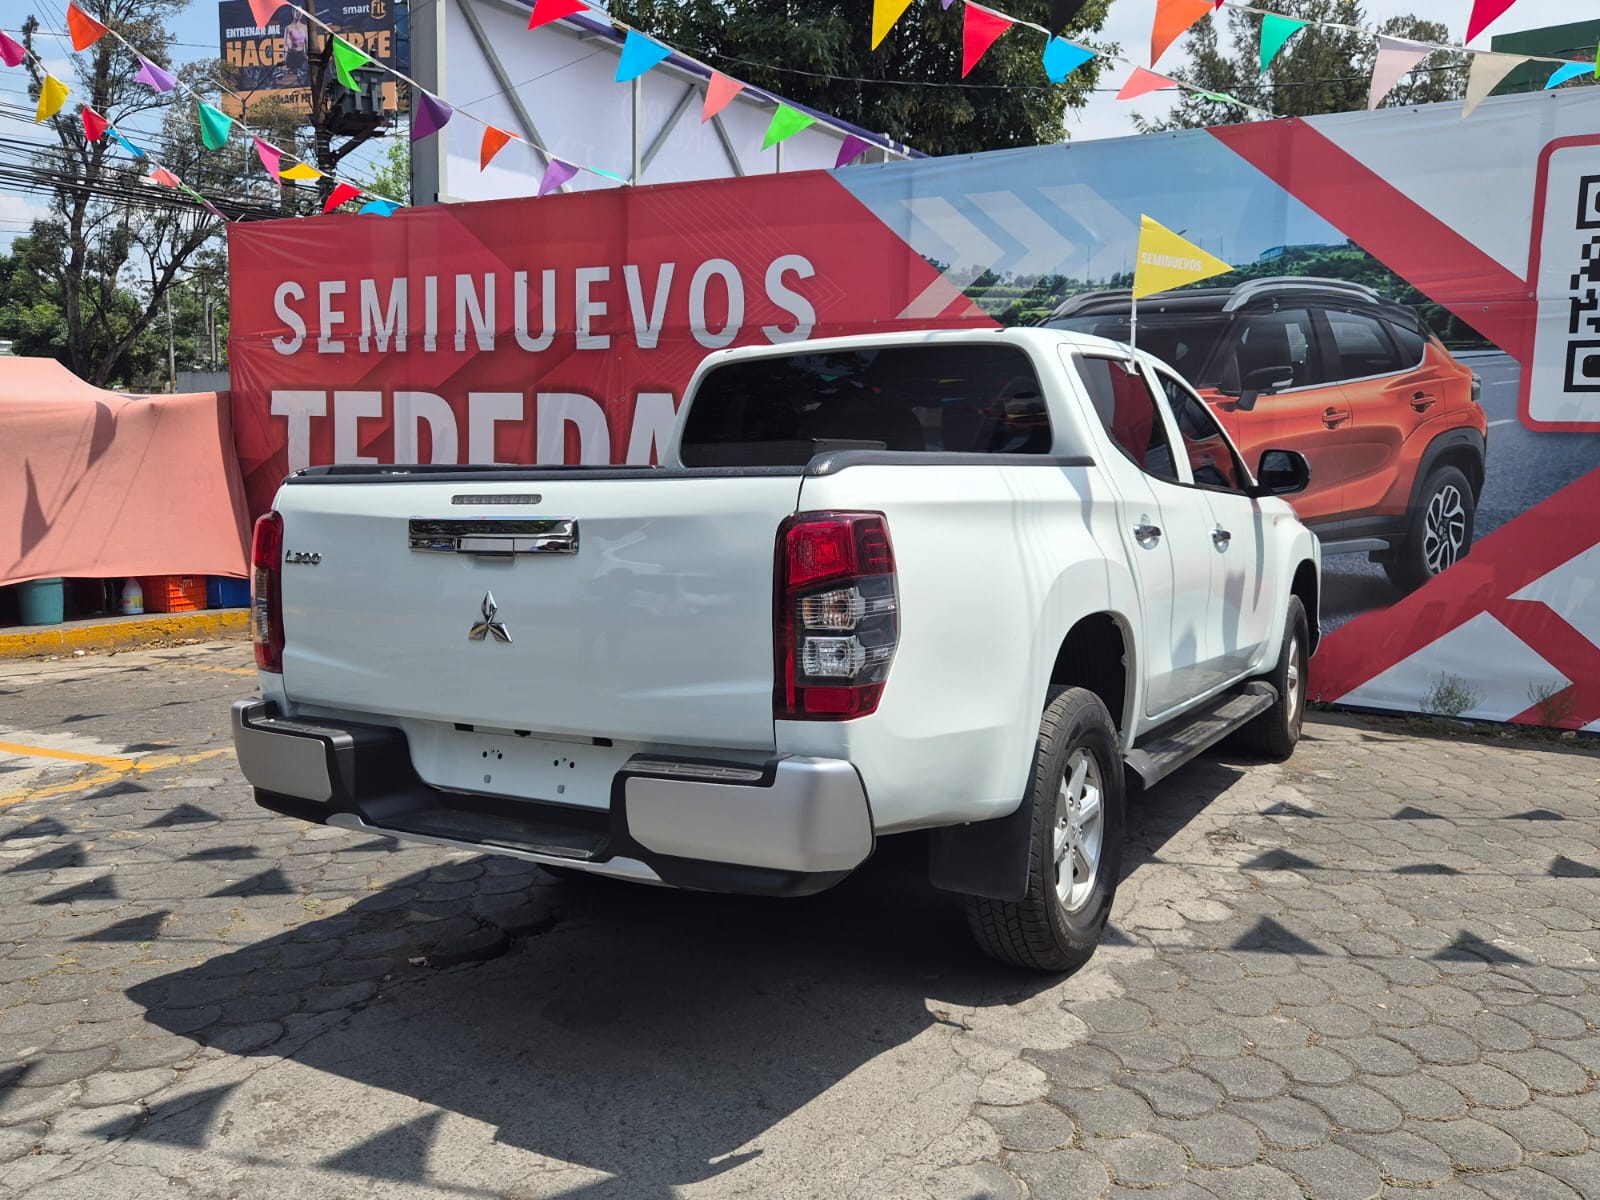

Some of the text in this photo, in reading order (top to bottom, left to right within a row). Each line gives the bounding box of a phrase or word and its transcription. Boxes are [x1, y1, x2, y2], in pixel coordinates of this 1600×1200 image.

[342, 4, 370, 15] smart
[268, 24, 281, 35] ME
[1141, 252, 1202, 272] SEMINUEVOS
[272, 254, 817, 356] SEMINUEVOS
[285, 549, 322, 565] L200
